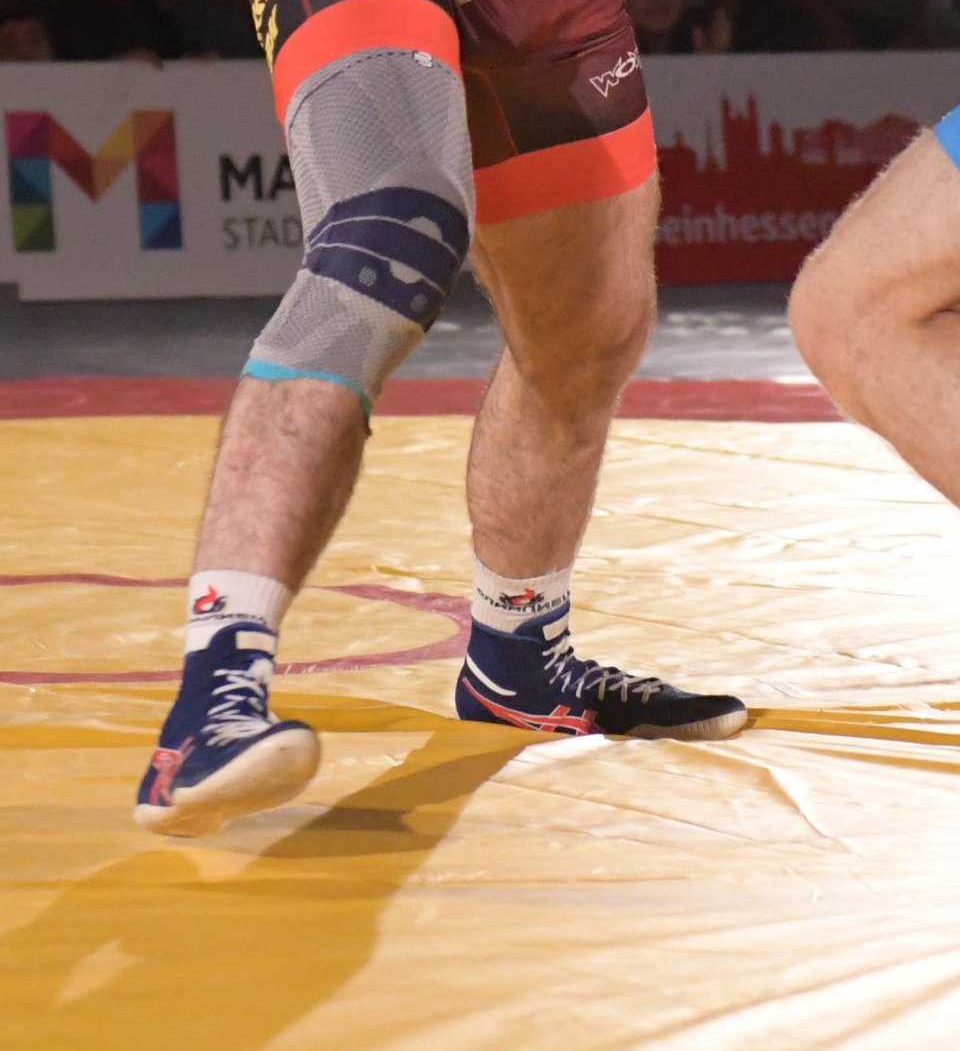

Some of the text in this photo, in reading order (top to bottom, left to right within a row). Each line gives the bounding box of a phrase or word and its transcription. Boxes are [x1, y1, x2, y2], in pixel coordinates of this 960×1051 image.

[219, 153, 296, 201] MA
[223, 216, 304, 248] STAD
[656, 204, 842, 246] einhessen
